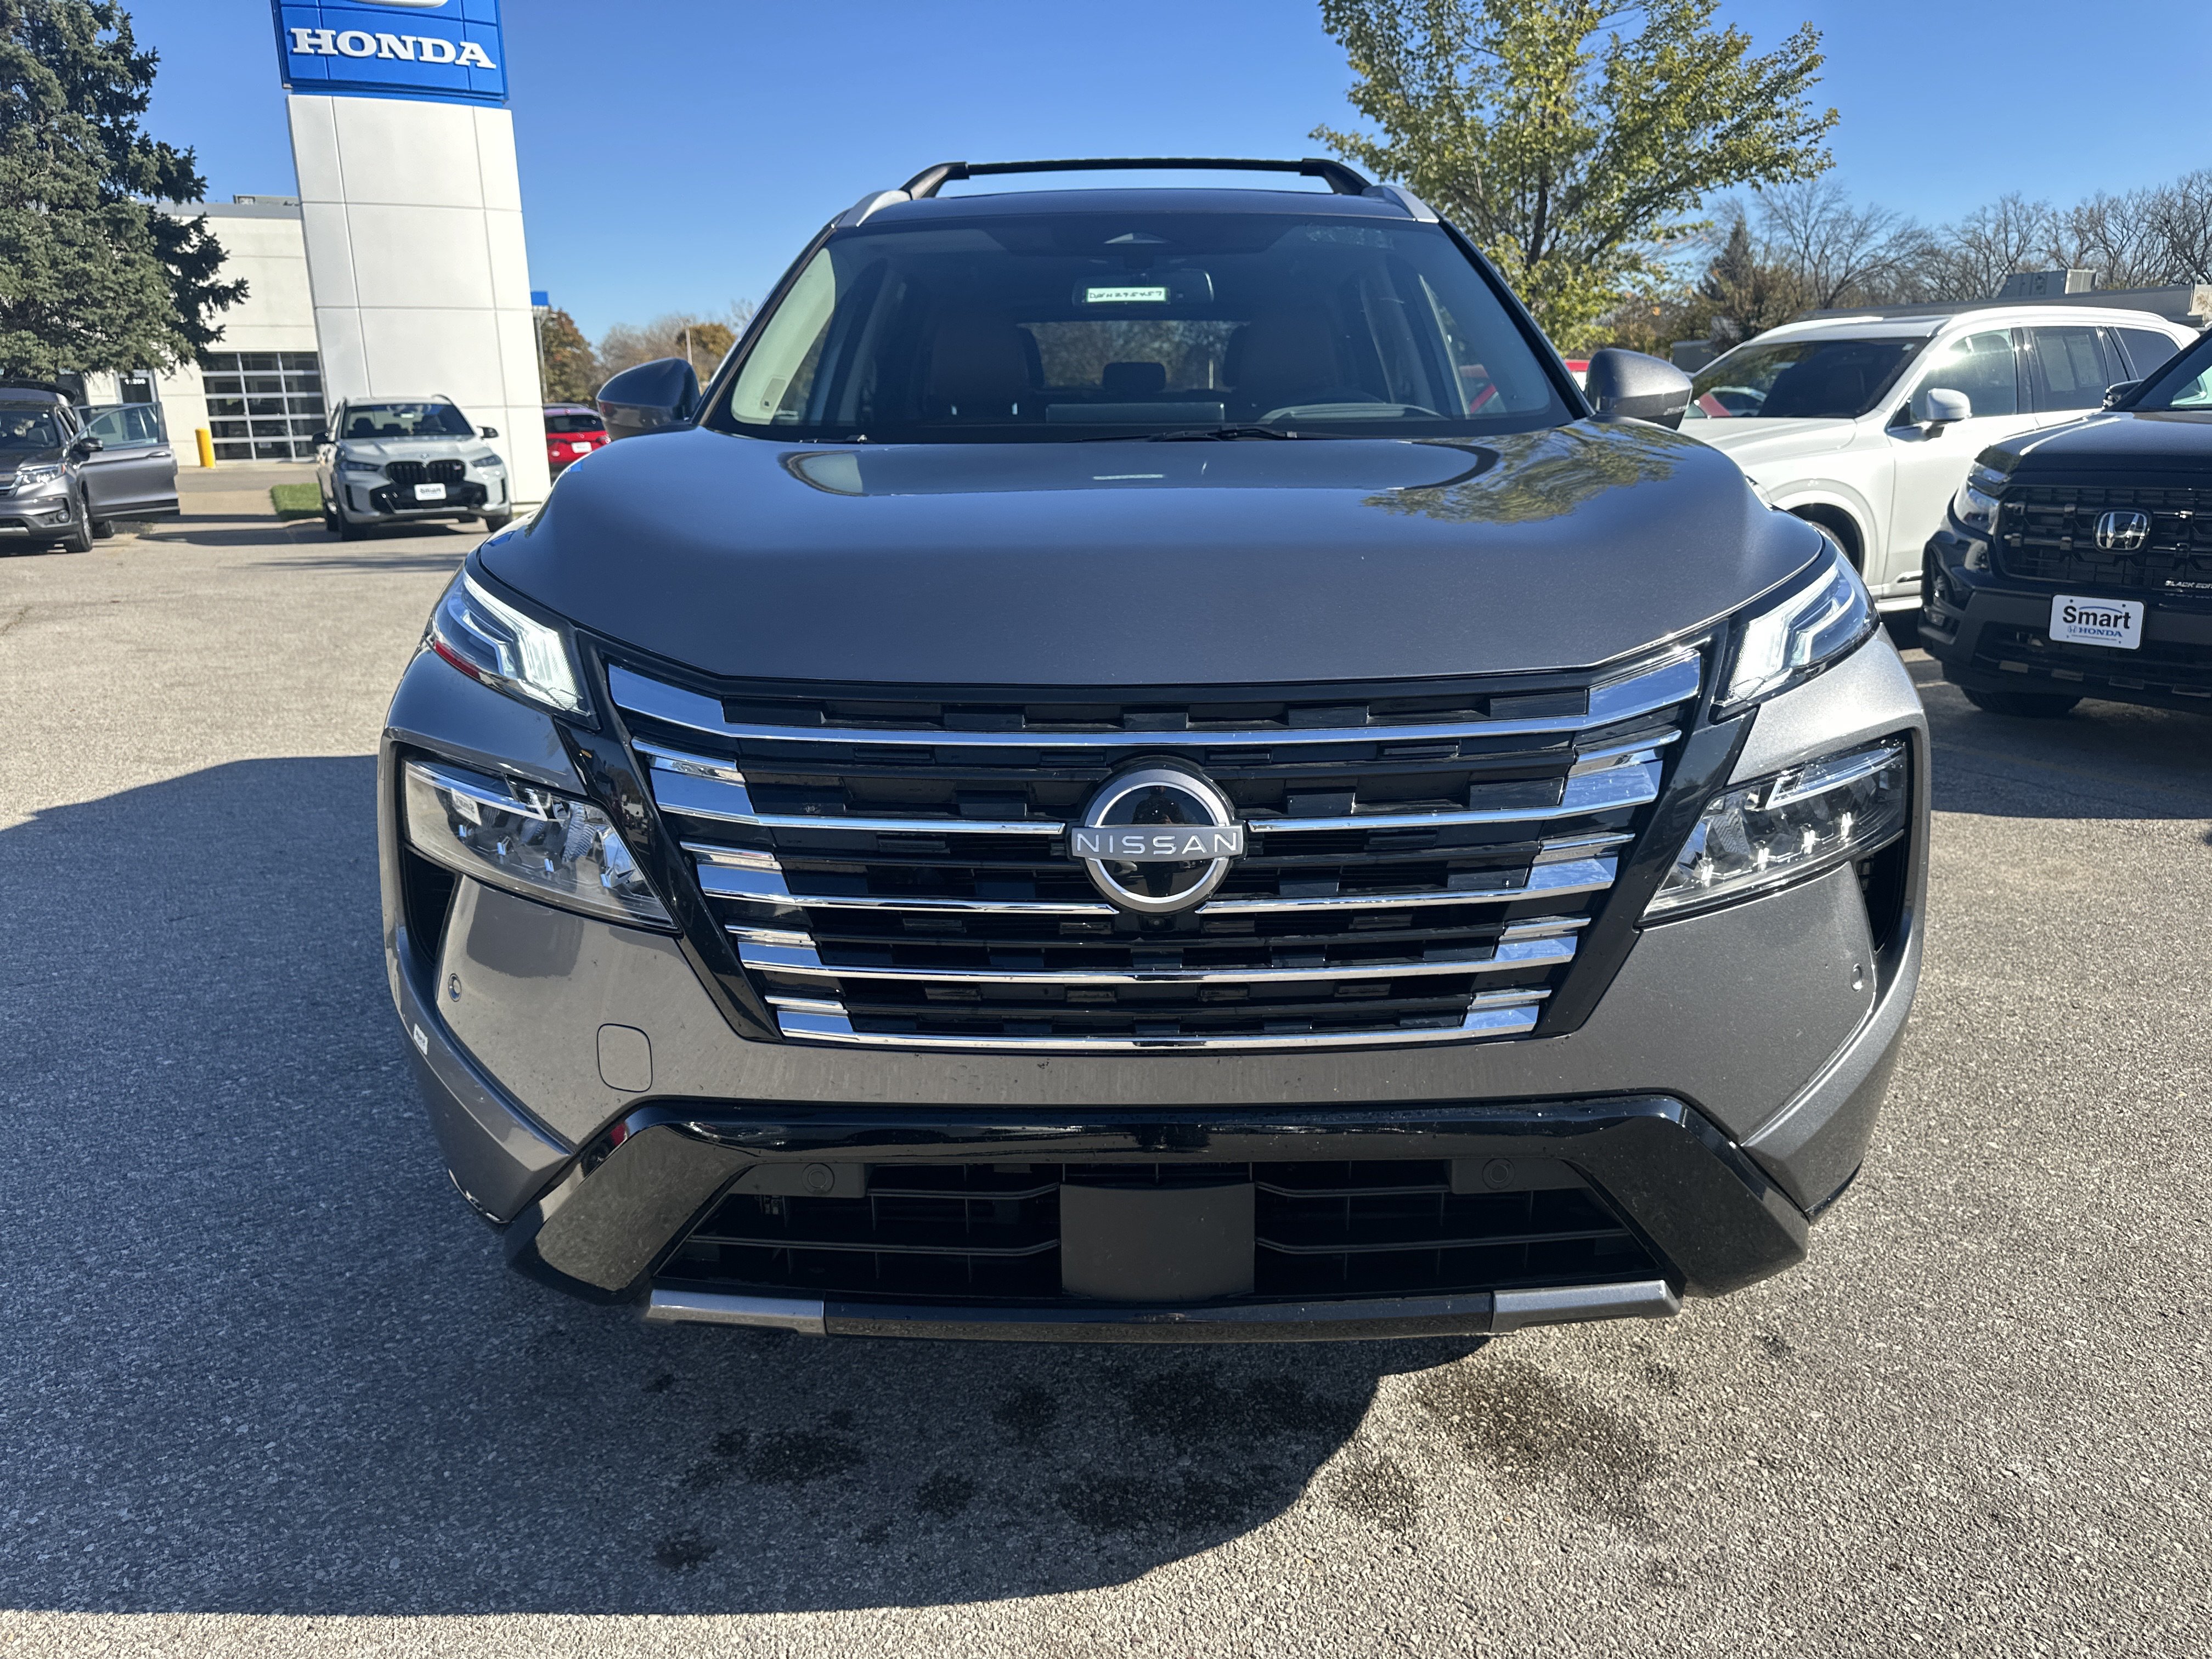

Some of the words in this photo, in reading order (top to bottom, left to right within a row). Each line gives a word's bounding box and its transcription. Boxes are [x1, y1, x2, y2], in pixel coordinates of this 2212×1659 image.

[290, 27, 496, 69] HONDA
[2063, 605, 2131, 629] Smart
[2079, 627, 2123, 637] HONDA
[1077, 832, 1238, 855] NISSAN
